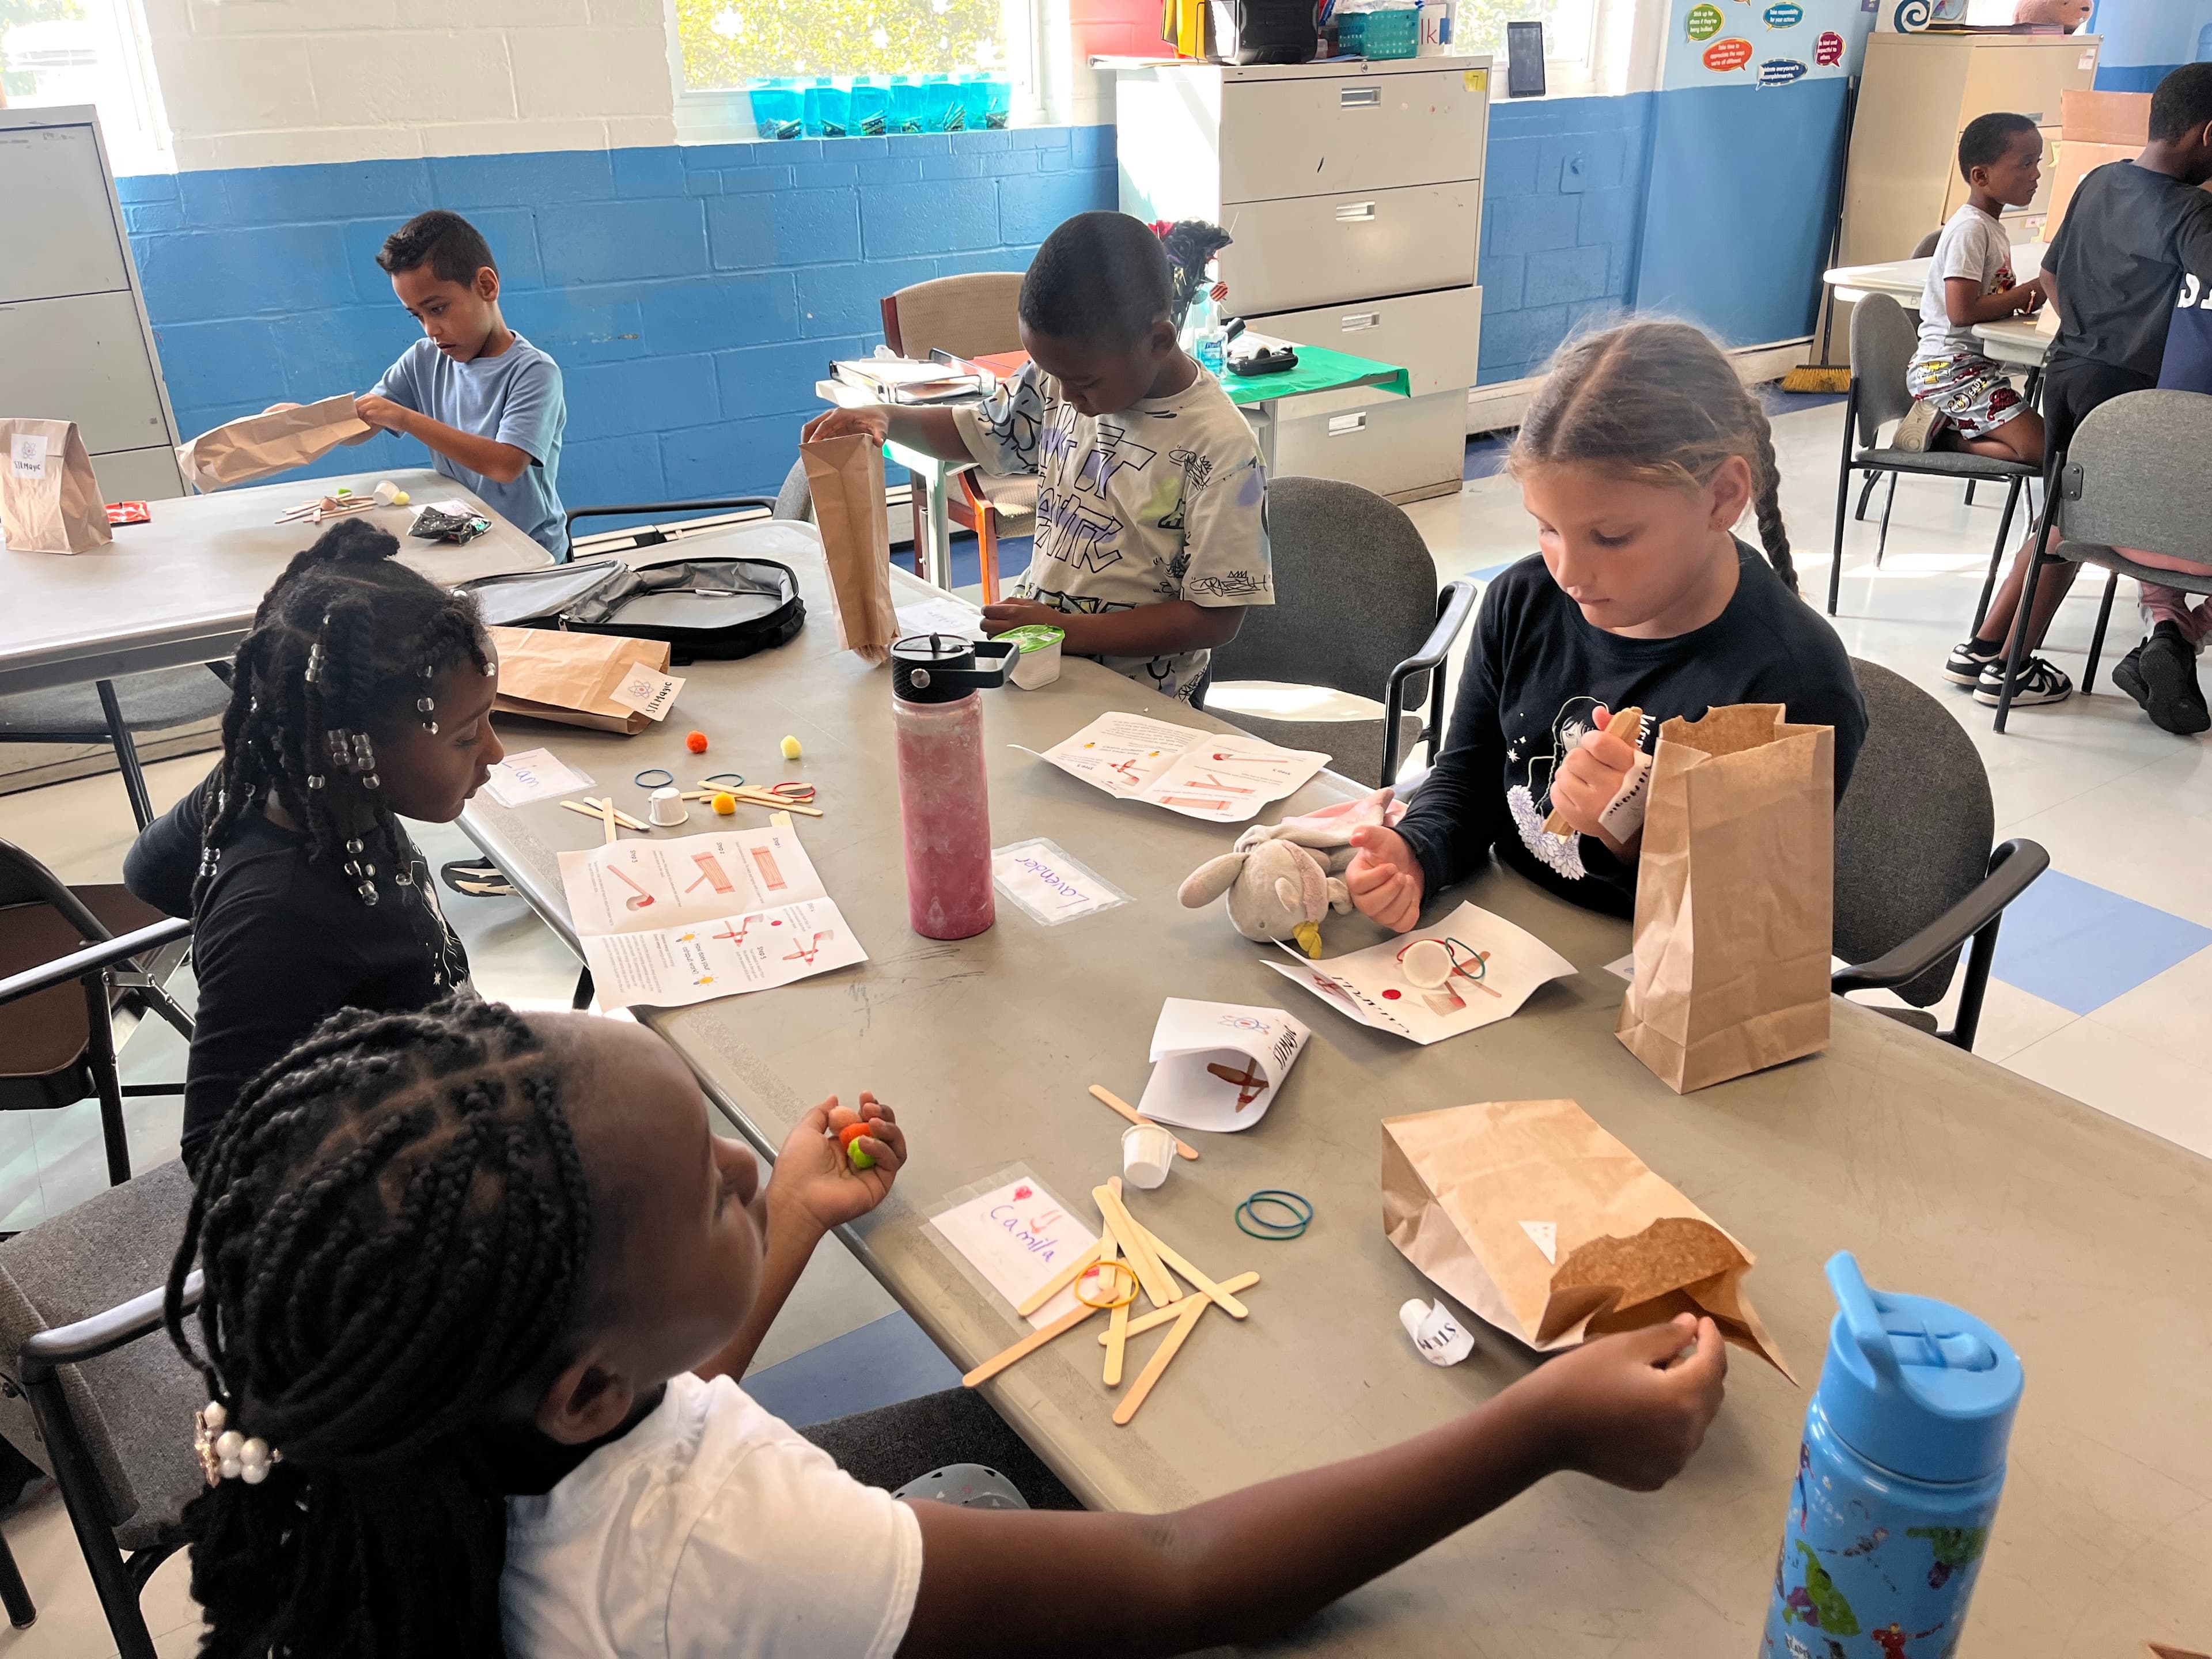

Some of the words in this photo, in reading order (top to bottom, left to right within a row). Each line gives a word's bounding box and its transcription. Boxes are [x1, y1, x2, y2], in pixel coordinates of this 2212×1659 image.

[14, 461, 41, 472] STEMagic
[645, 681, 672, 713] STEMagic
[501, 754, 540, 790] Liam
[1014, 856, 1090, 910] Lavender
[683, 946, 694, 962] catapult
[698, 952, 706, 961] does
[757, 946, 765, 956] Step
[701, 961, 710, 970] your
[989, 1204, 1054, 1263] Camila
